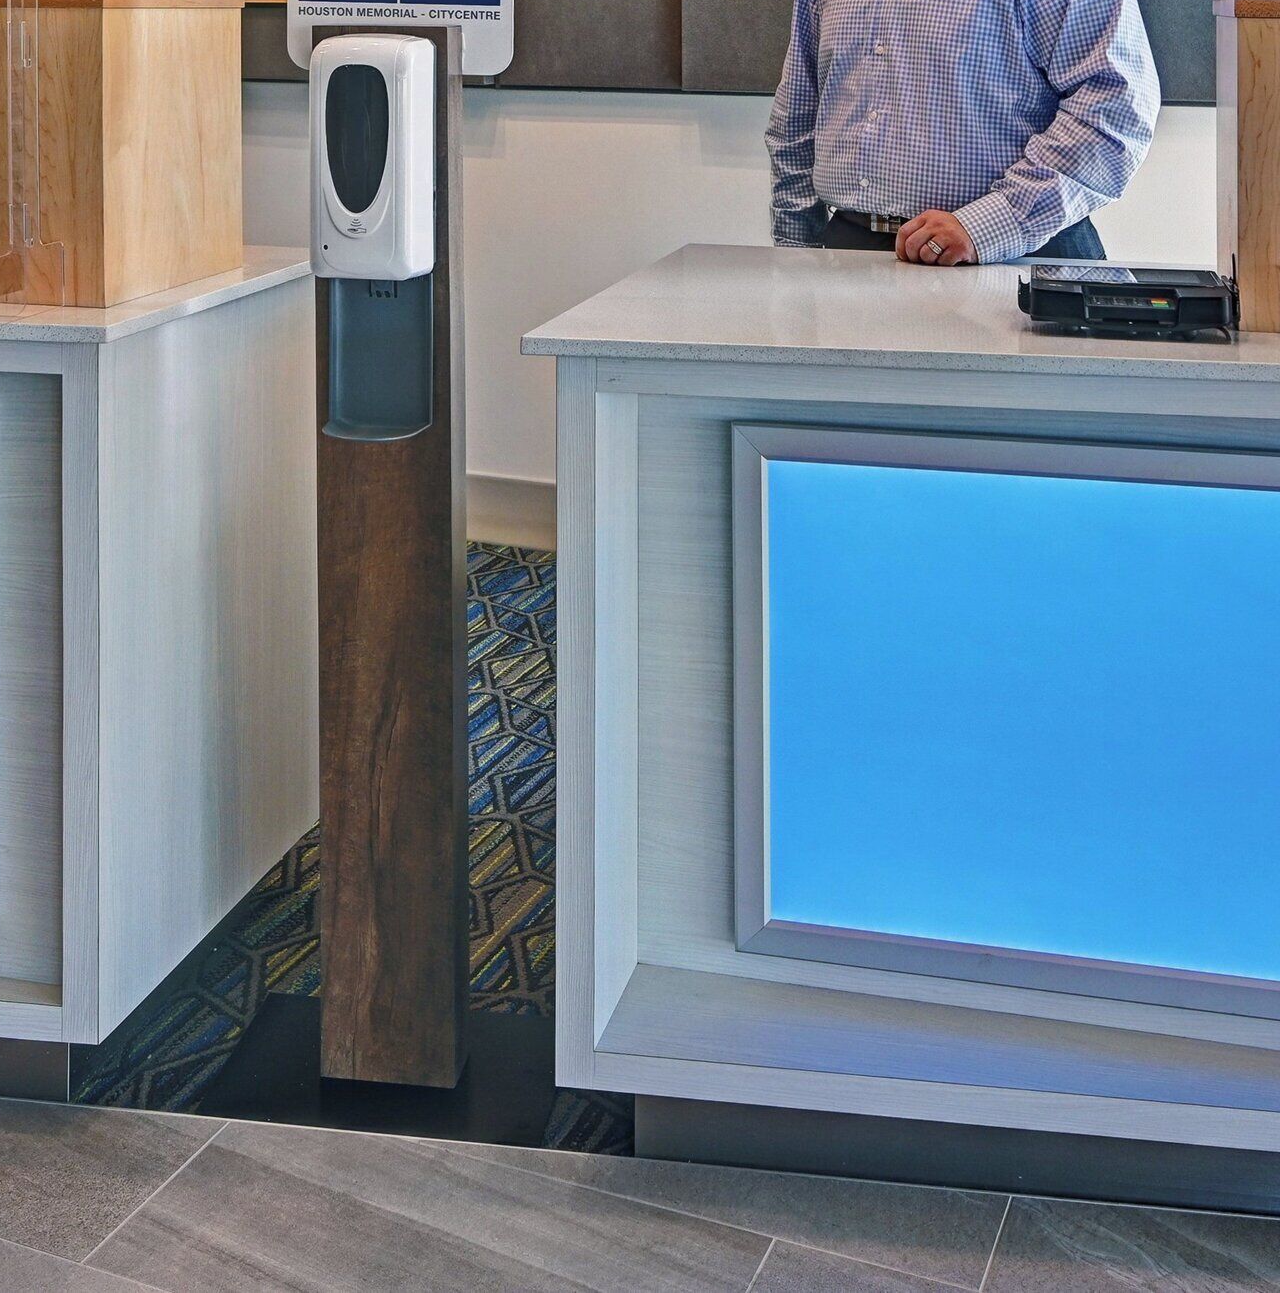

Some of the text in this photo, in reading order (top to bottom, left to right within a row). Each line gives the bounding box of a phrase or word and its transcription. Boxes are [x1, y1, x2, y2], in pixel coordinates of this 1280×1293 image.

[299, 7, 353, 16] HOUSTON
[357, 8, 417, 18] MEMORIAL
[429, 9, 501, 20] CITYCENTRE
